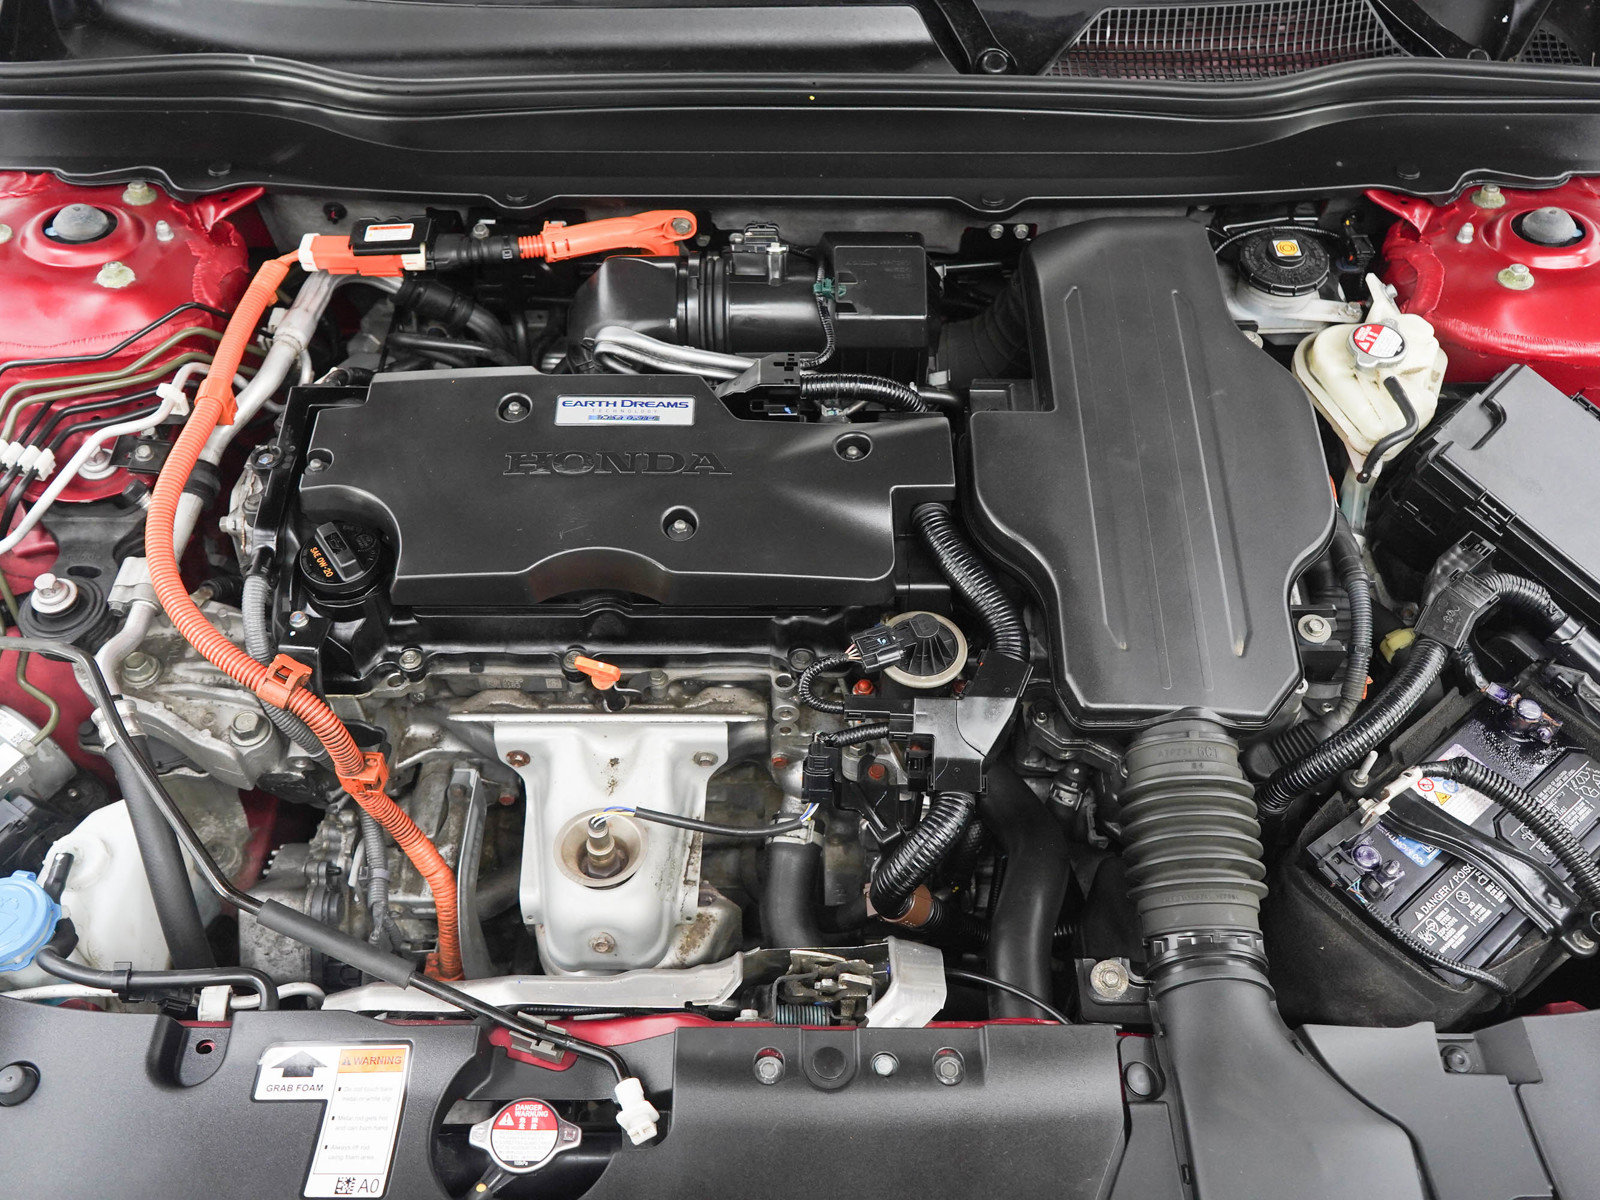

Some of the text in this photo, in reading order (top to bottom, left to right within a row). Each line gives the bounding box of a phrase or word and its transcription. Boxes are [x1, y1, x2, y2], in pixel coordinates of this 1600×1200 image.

[562, 399, 690, 409] EARTH DREAMS
[502, 451, 733, 475] HONDA
[309, 547, 322, 560] SAE
[1420, 884, 1451, 914] DANGER
[354, 1056, 402, 1065] WARNING
[266, 1084, 324, 1092] GRAB FOAM
[357, 1178, 380, 1193] A0
